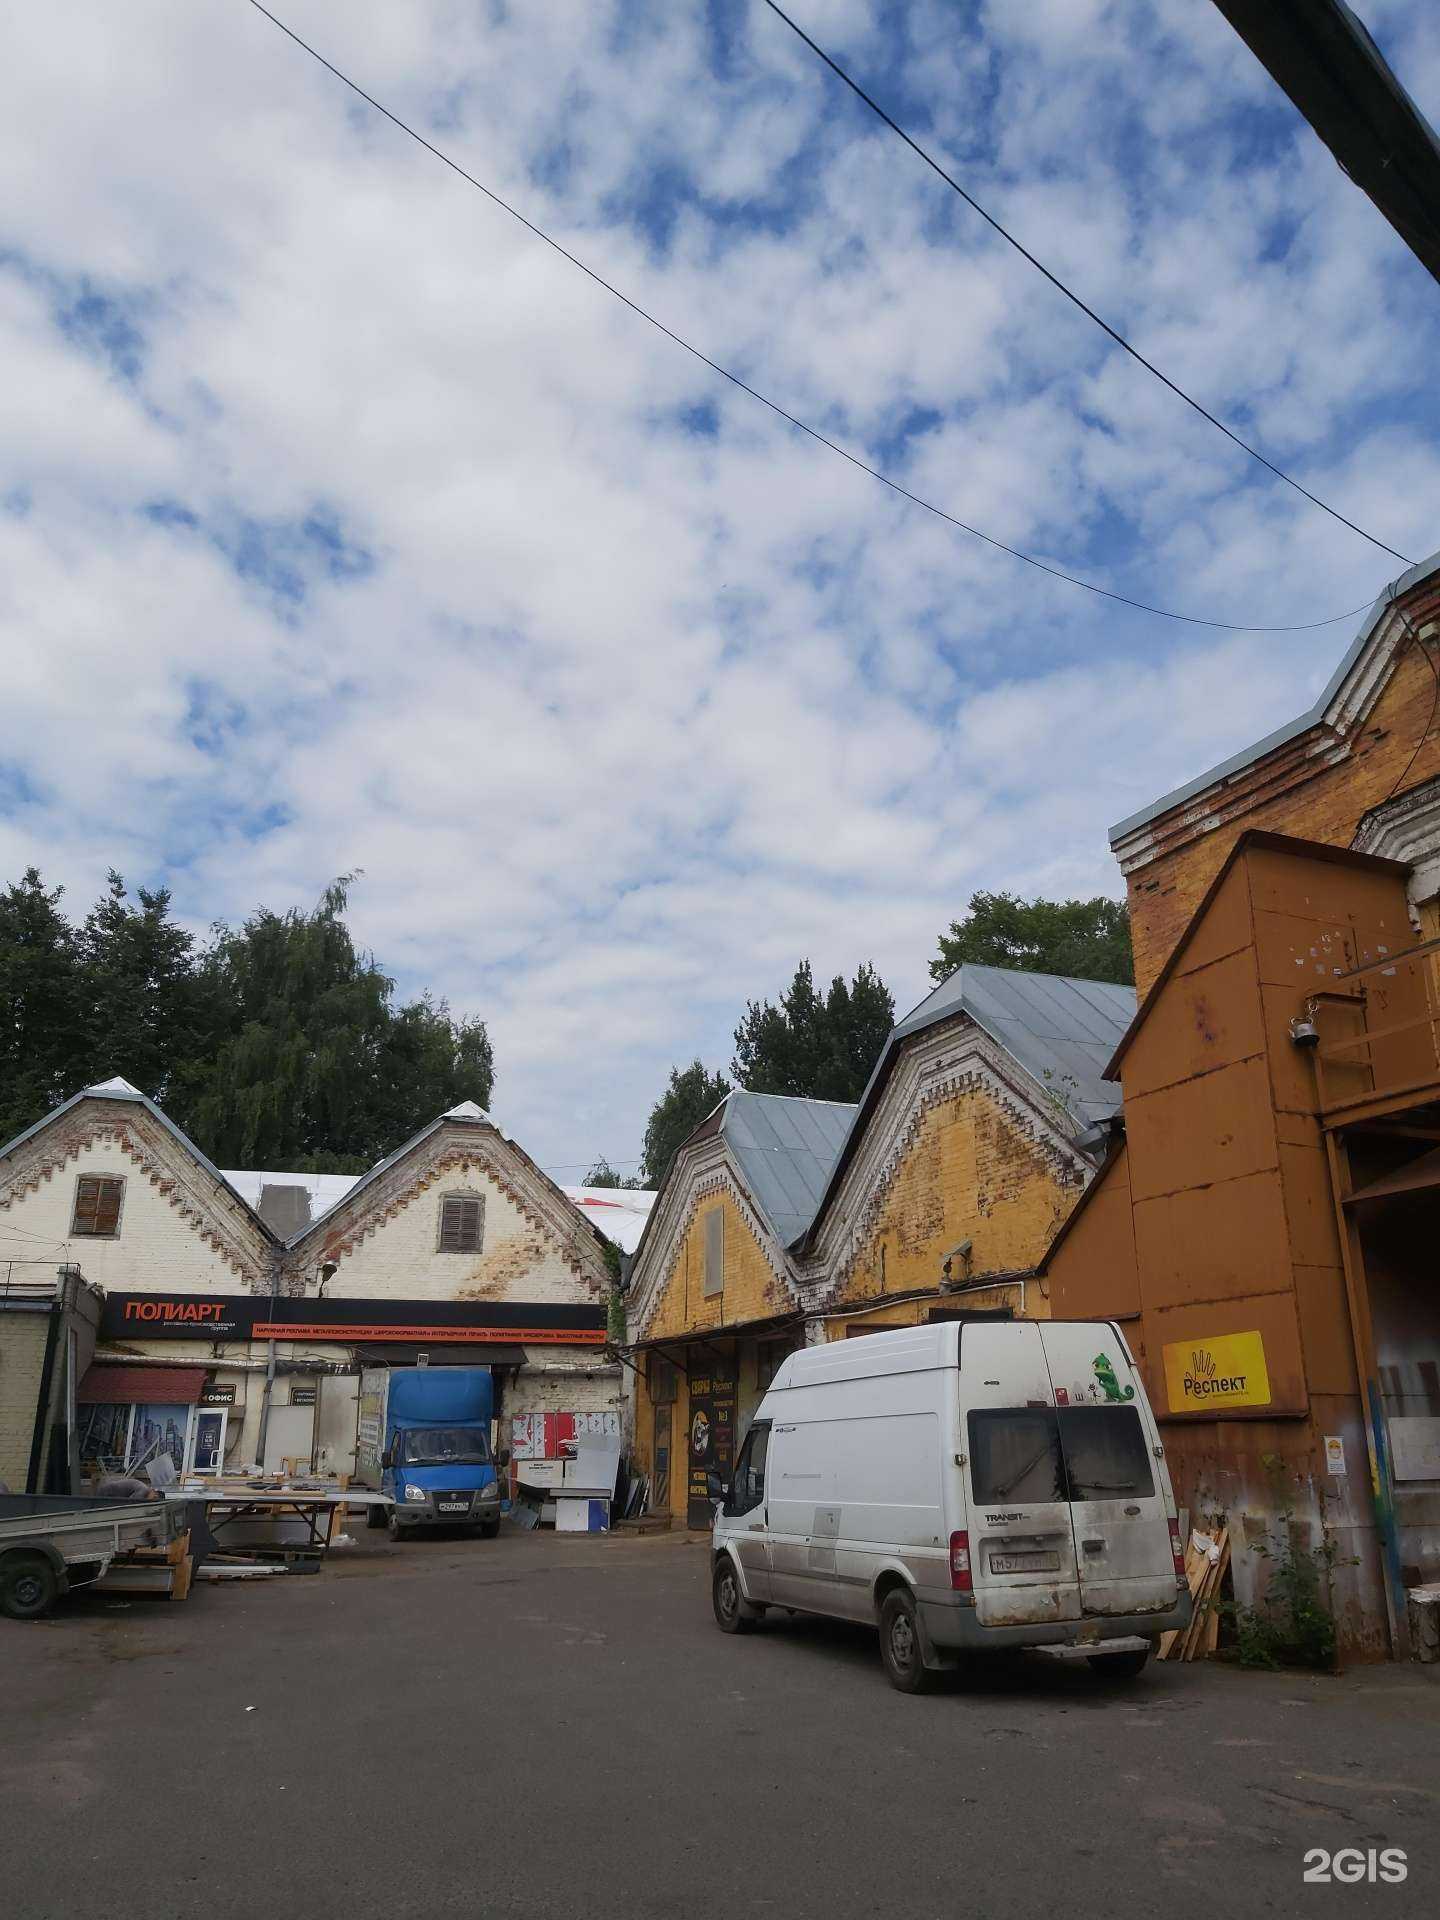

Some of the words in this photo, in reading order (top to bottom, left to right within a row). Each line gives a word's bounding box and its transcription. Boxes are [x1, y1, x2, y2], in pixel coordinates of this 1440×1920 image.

[125, 1301, 225, 1321] ПОЛИАРТ
[1183, 1376, 1247, 1398] Респект
[208, 1393, 233, 1403] ОФИС
[985, 1512, 1024, 1522] TRANSIT
